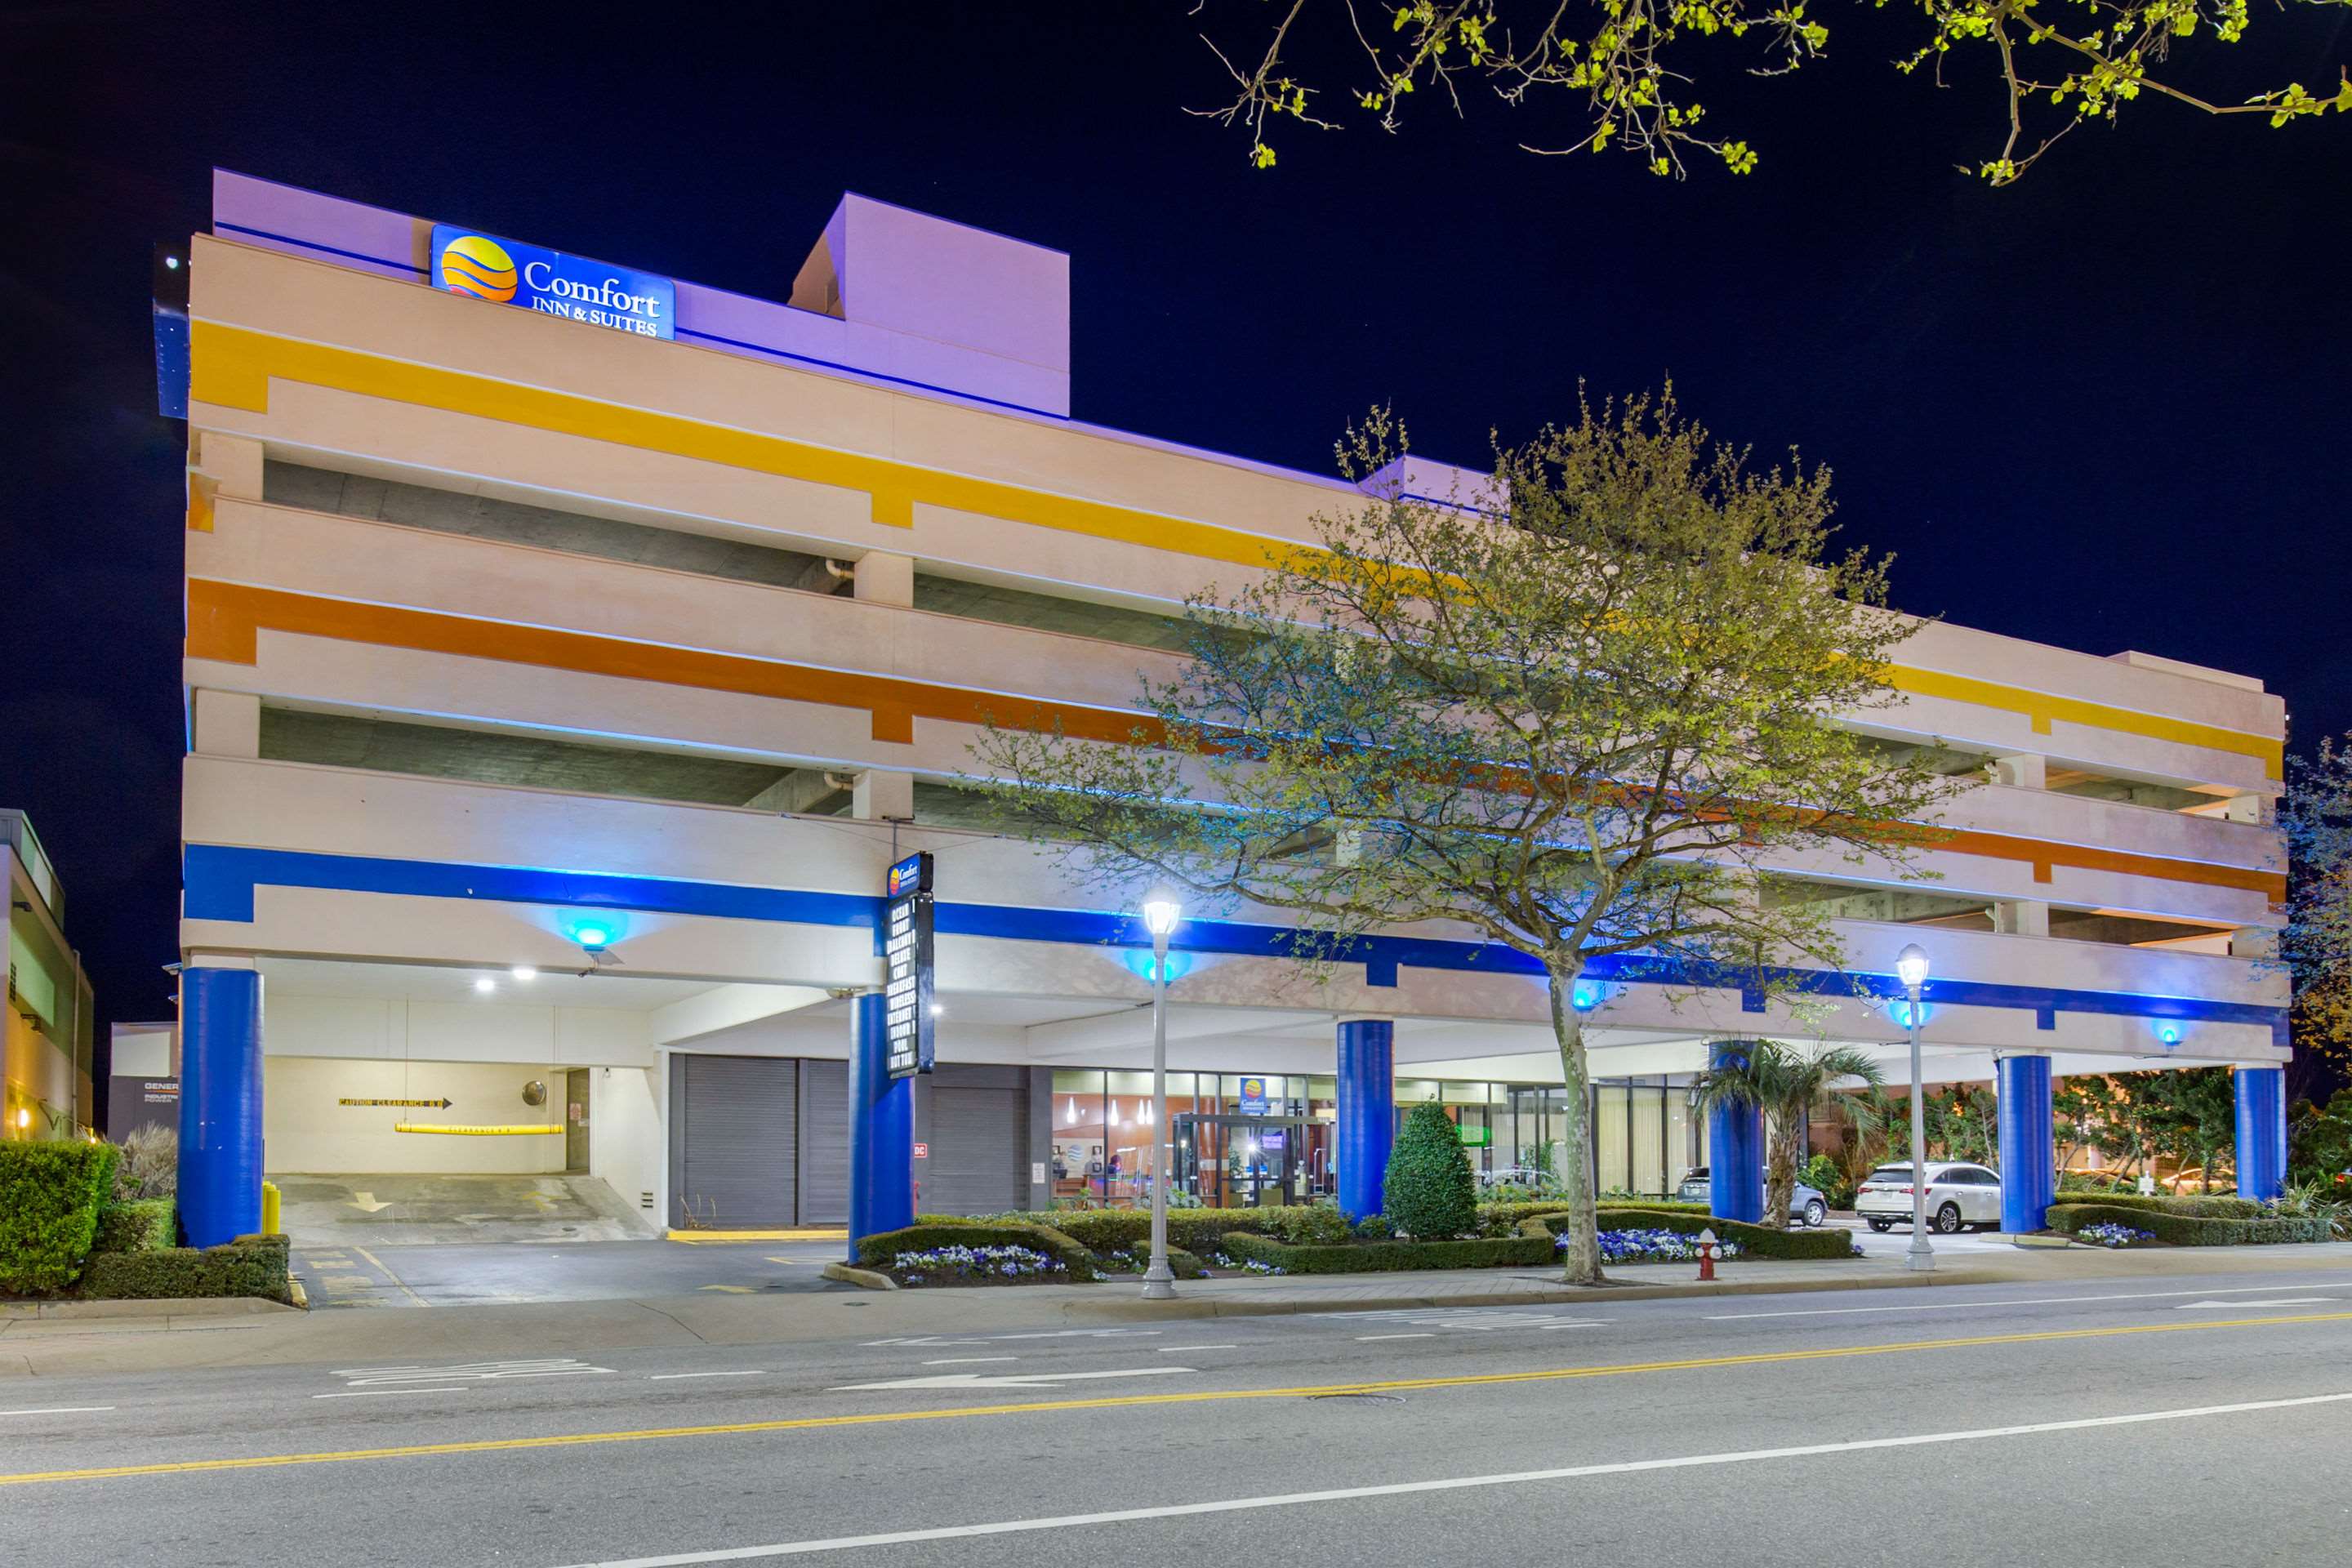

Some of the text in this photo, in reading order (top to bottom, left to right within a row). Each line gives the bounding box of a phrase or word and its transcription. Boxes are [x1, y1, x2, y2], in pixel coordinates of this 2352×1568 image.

[524, 261, 660, 318] Comfort
[532, 296, 657, 337] INN & SUITES
[900, 864, 918, 881] Comfort
[887, 975, 915, 997] BREAKFAST
[889, 989, 916, 1010] WIRELESS
